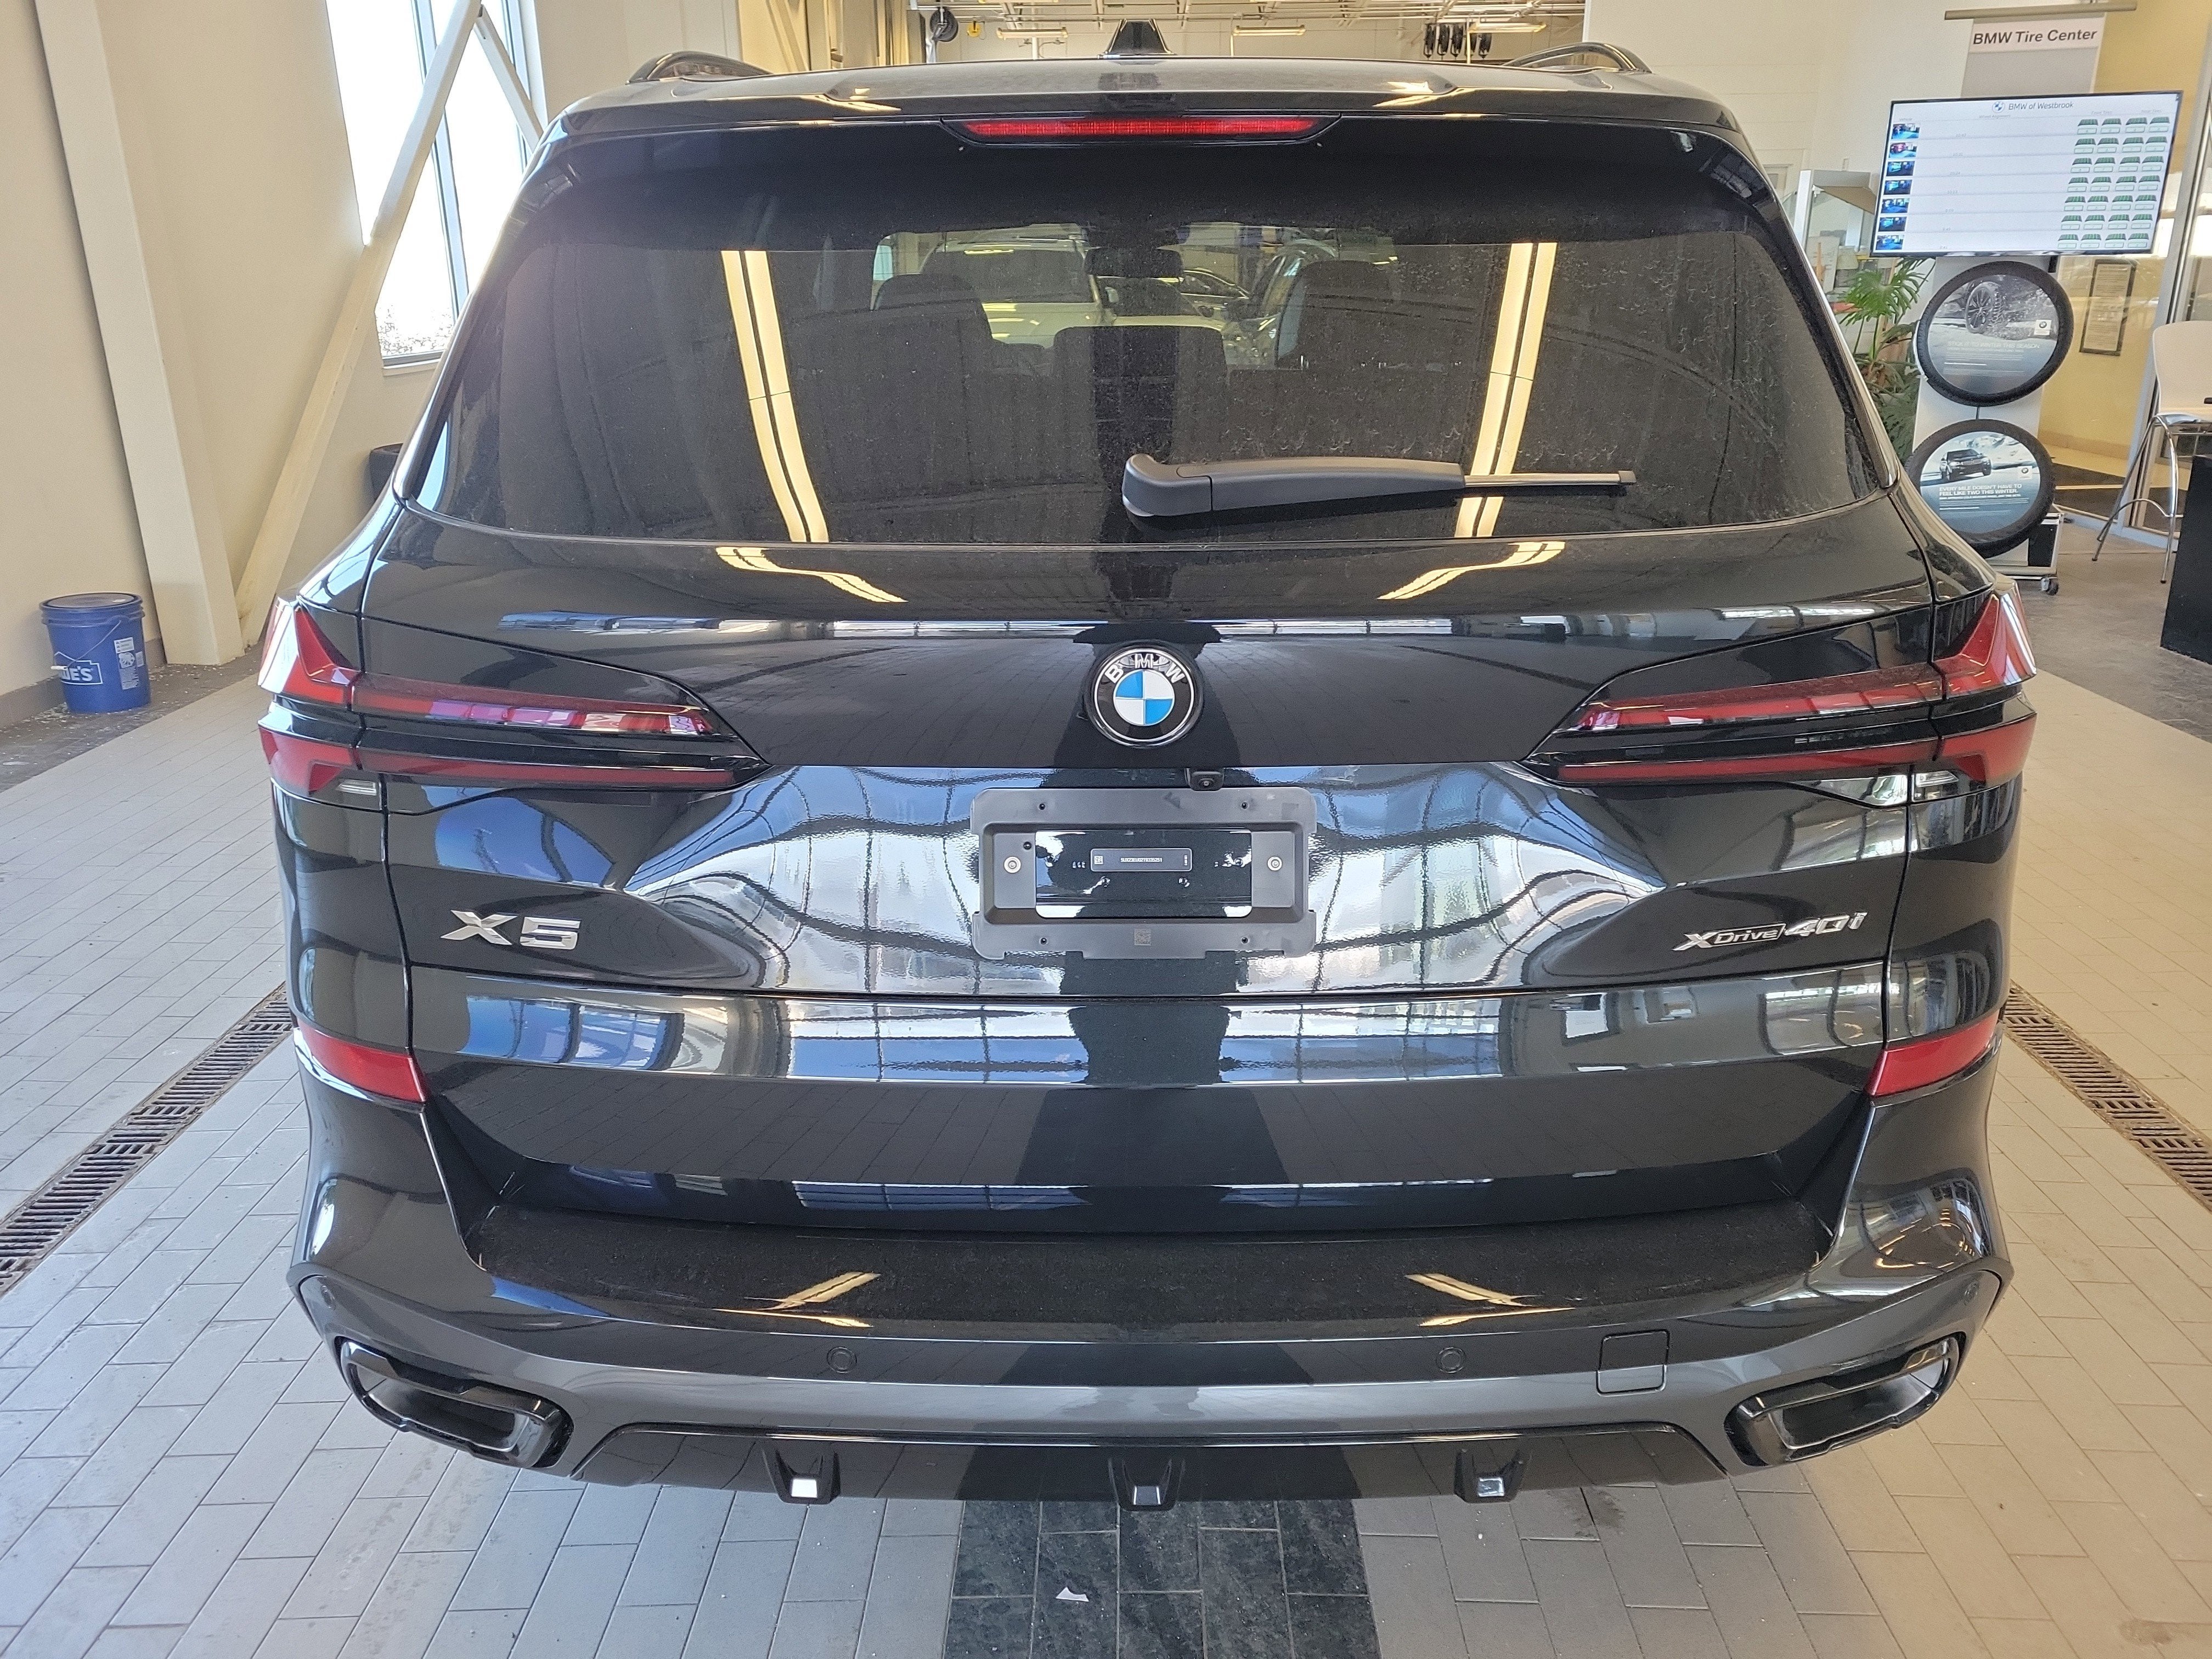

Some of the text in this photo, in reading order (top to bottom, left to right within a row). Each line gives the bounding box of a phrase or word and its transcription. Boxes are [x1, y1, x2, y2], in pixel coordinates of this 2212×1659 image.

[1973, 29, 2097, 44] BMW Tire Center
[1104, 653, 1185, 684] BMW
[440, 910, 581, 950] X5
